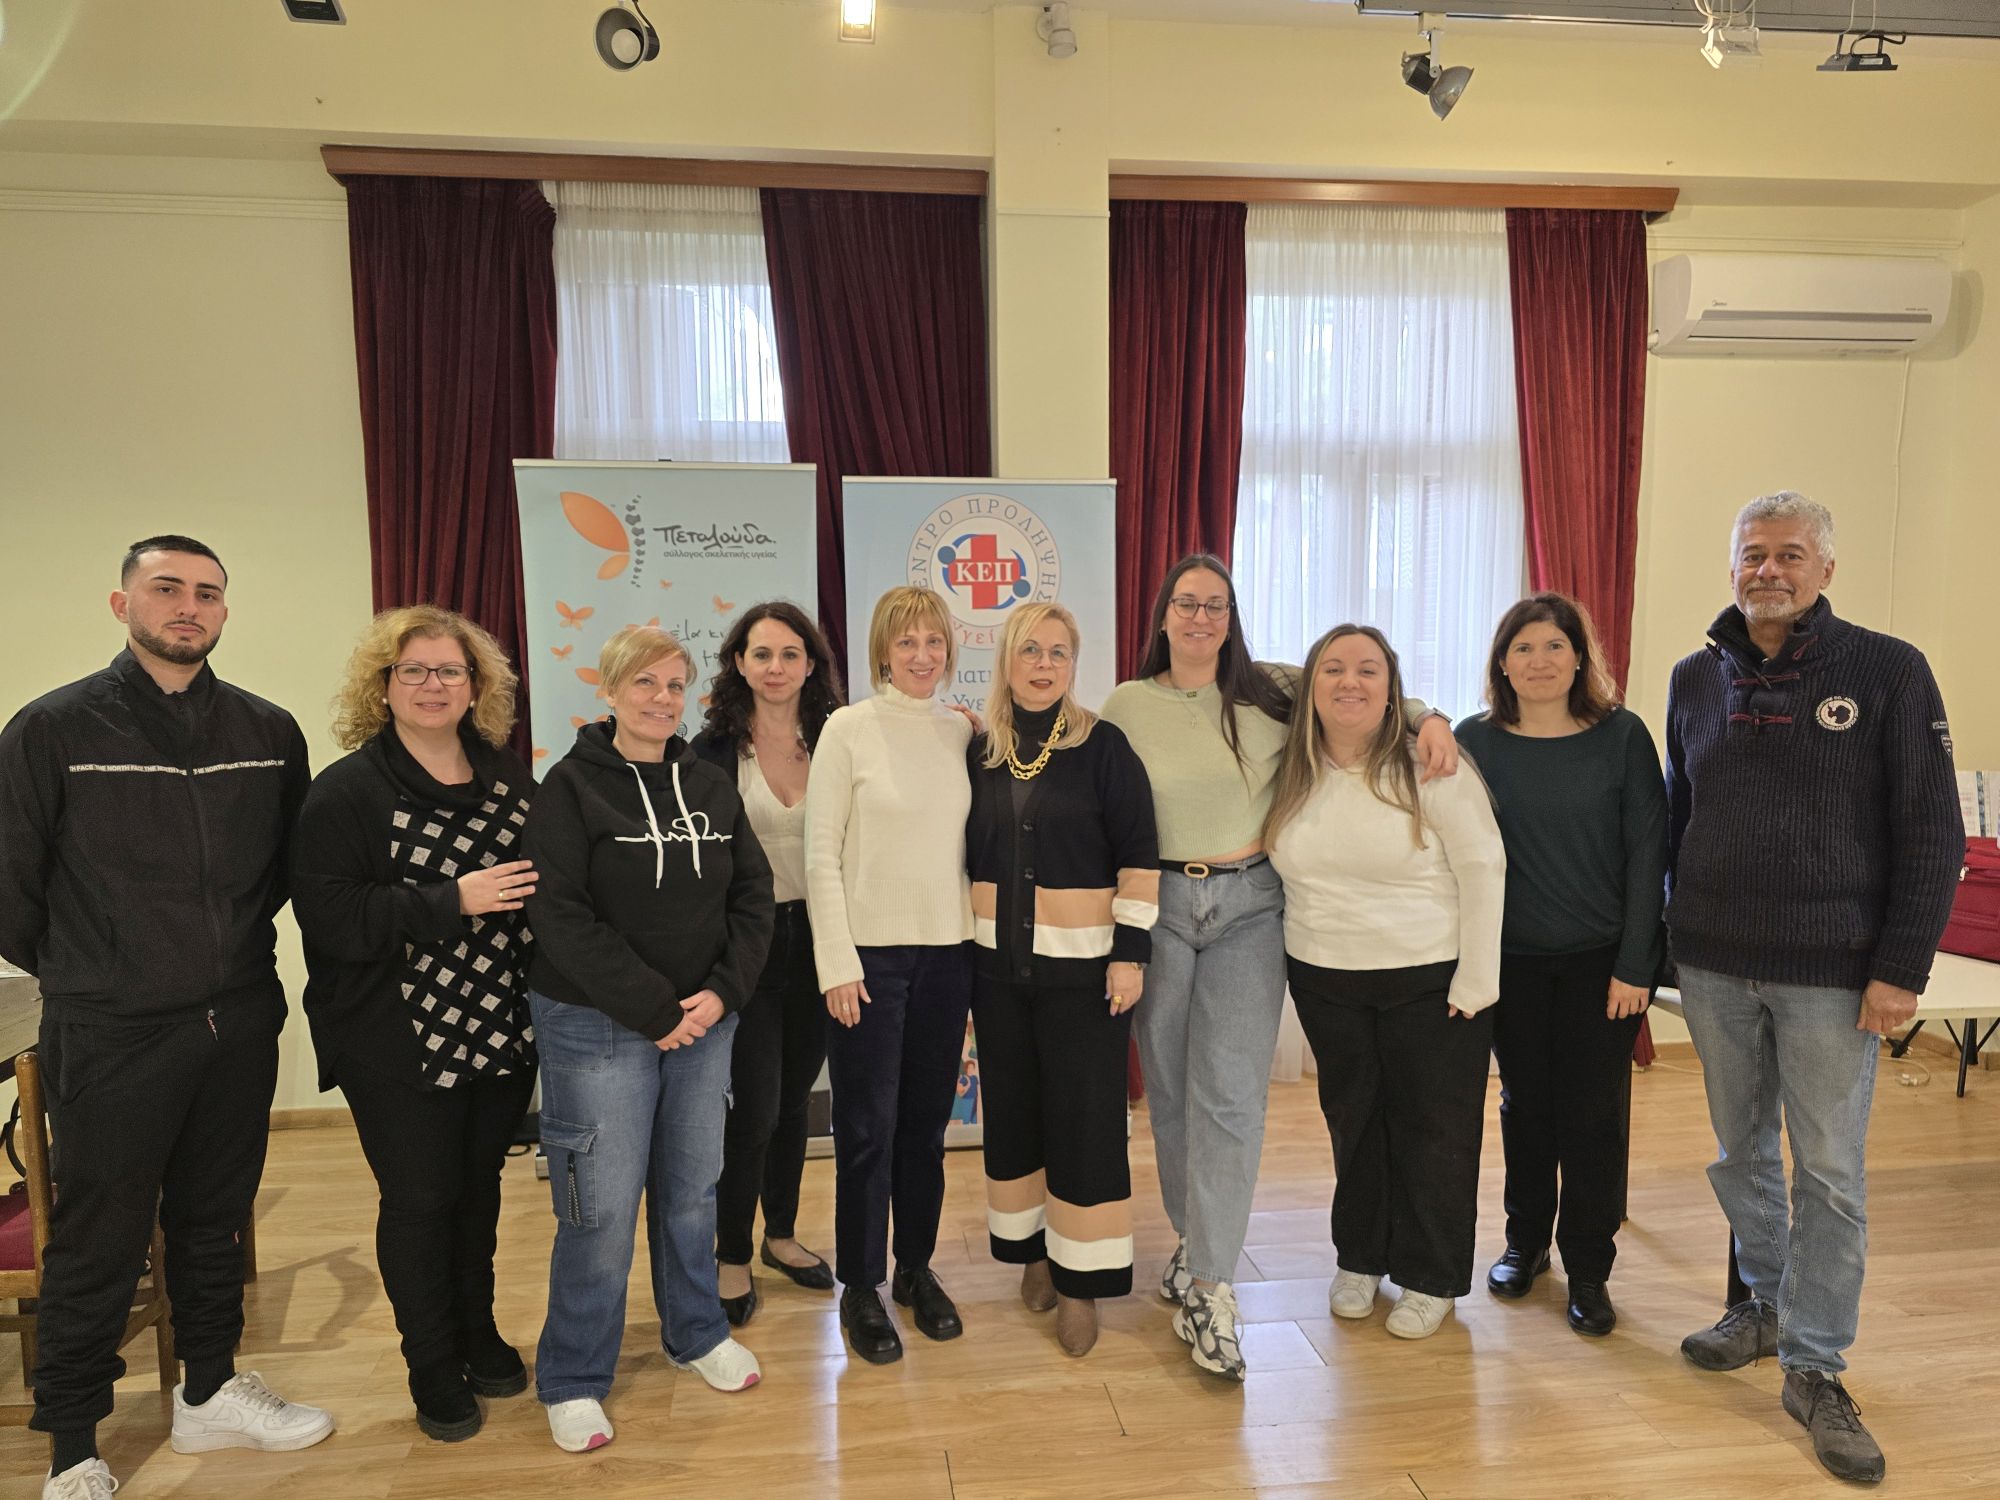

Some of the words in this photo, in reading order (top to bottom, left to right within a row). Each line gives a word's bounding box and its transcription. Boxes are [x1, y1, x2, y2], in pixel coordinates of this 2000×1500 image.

[663, 550, 704, 559] σύλλογος
[705, 550, 750, 559] σκελετικής
[751, 550, 777, 559] υγείας
[911, 509, 953, 590] ΕΝΤΡΟ
[956, 561, 1014, 583] ΚΕΠ
[107, 764, 130, 772] NORTH
